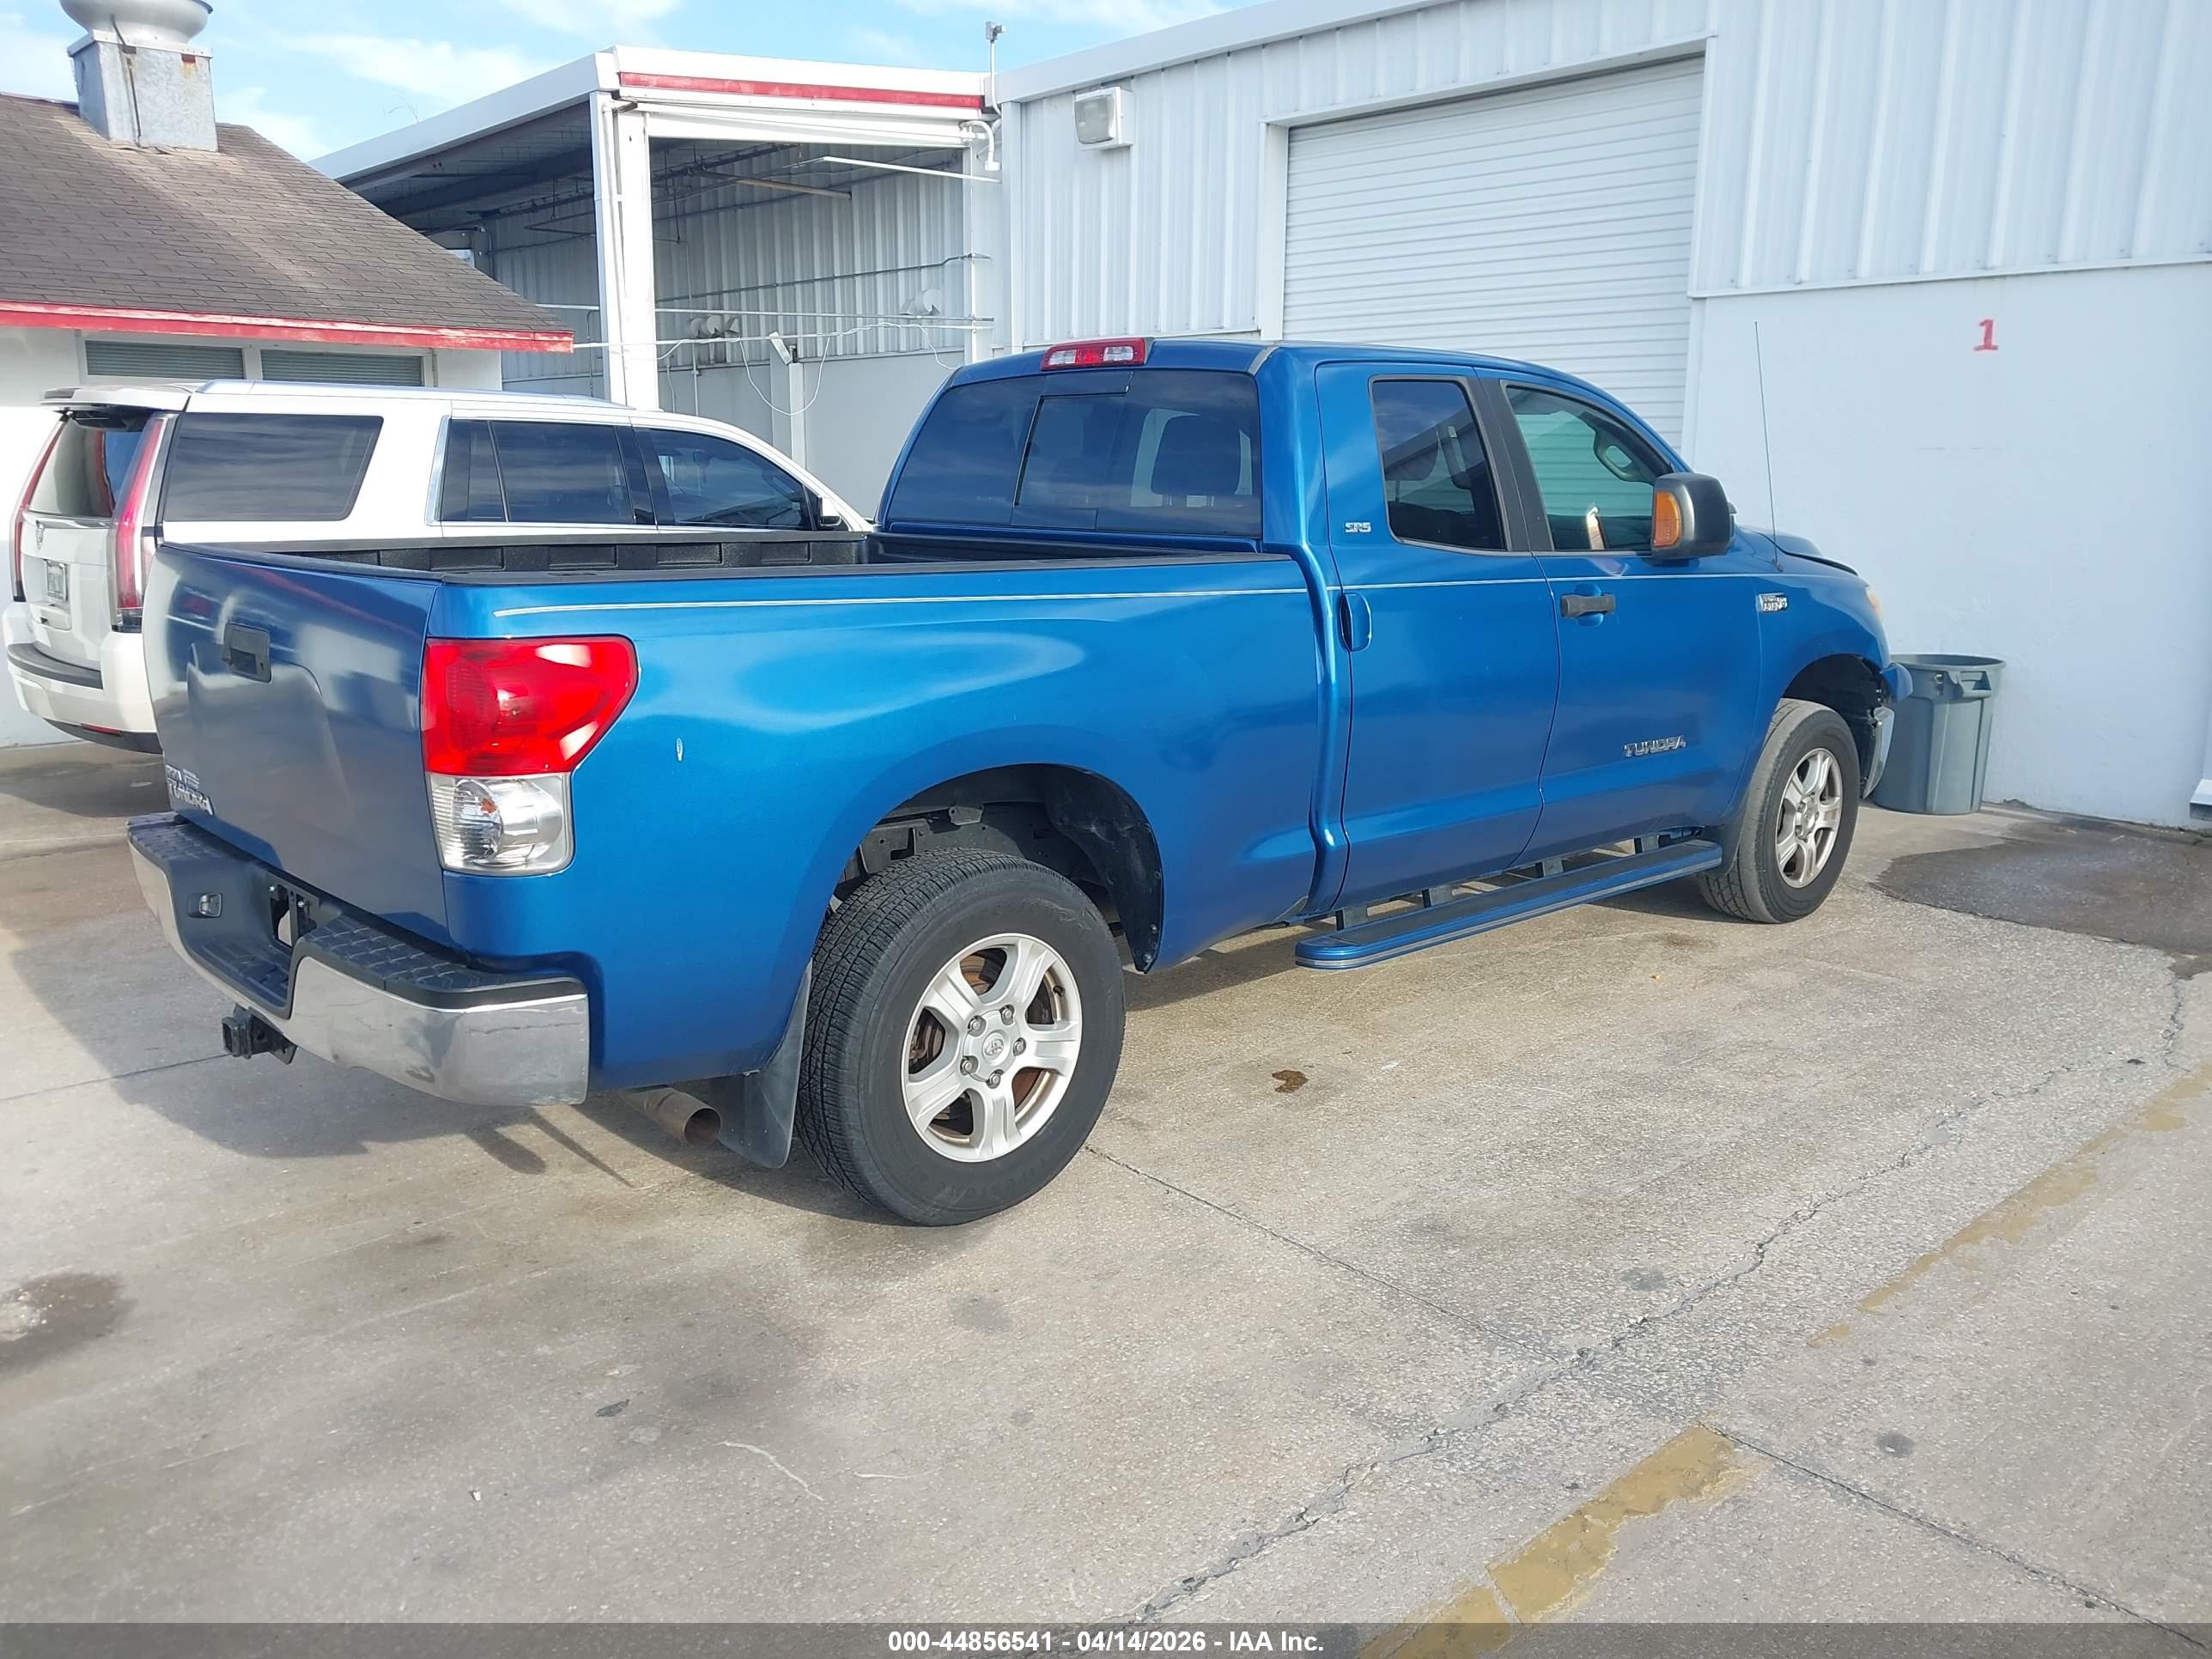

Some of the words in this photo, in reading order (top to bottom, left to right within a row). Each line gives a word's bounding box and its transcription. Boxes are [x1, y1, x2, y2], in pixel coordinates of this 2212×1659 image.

[1973, 319, 1999, 351] 1
[1345, 521, 1372, 533] SR5
[1624, 735, 1686, 757] TUNDRA
[167, 777, 214, 816] TUNDRA
